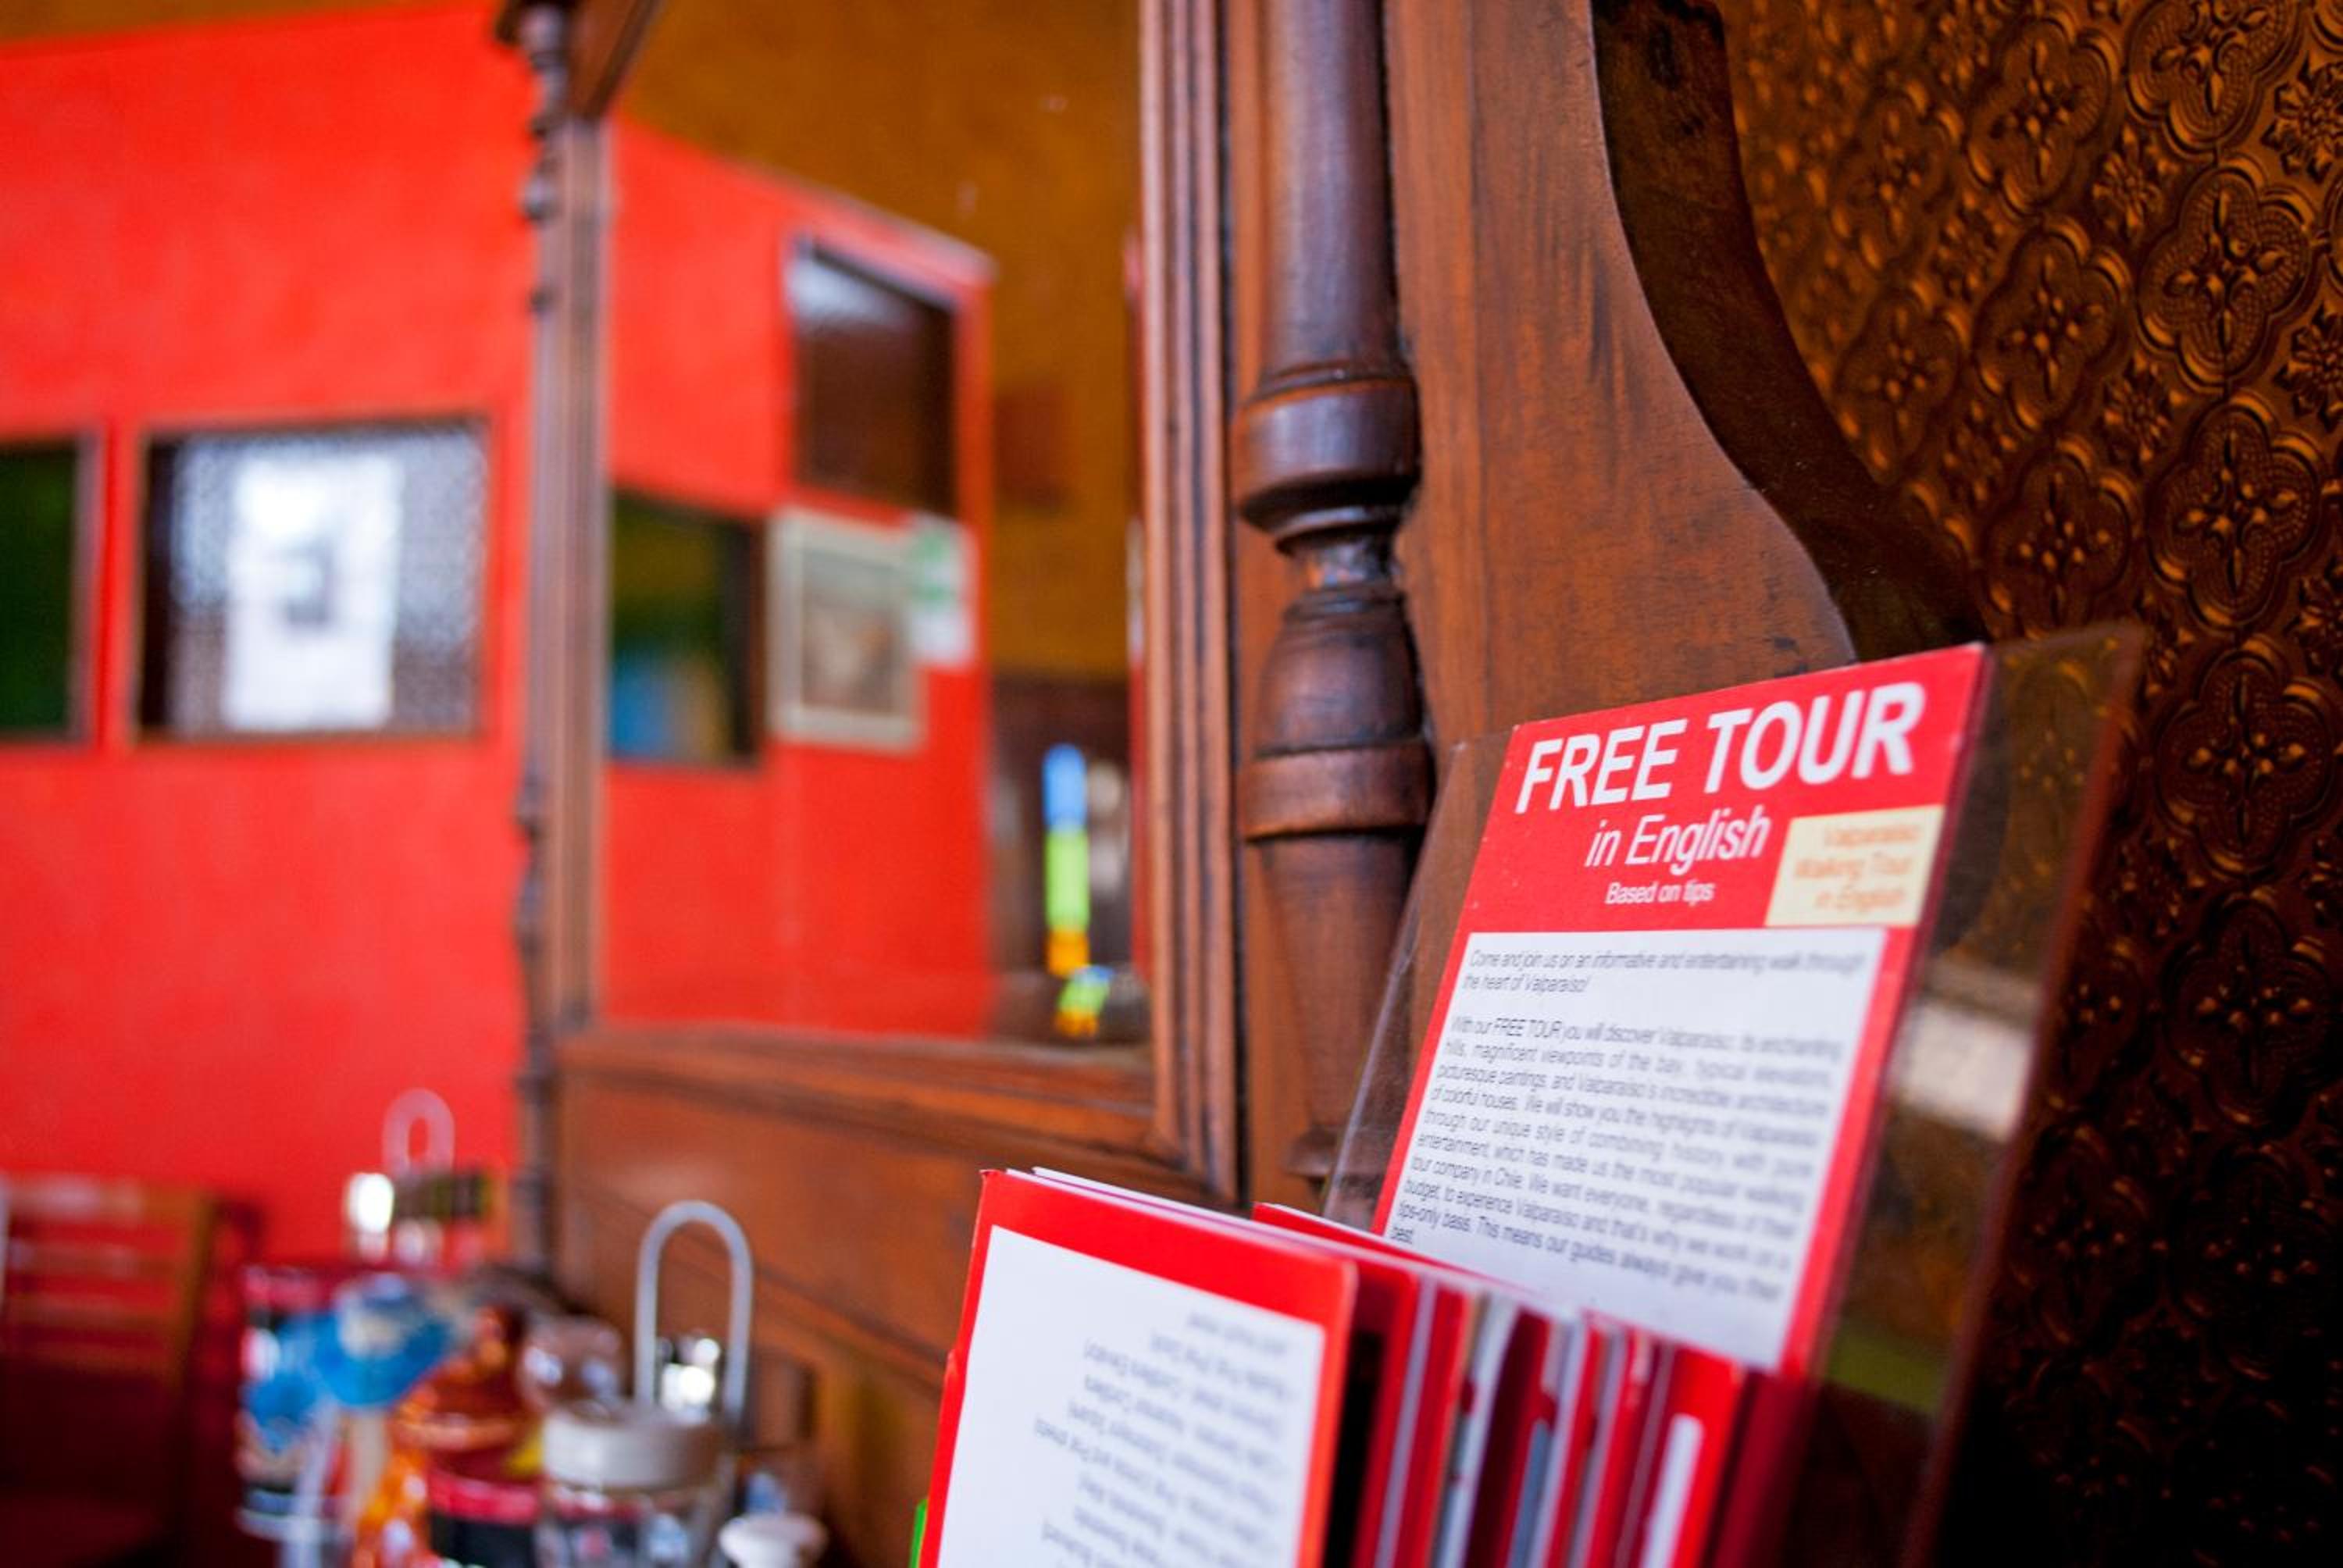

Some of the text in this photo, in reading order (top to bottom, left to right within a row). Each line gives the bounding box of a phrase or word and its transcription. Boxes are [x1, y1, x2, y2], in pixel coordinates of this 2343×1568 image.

[1515, 682, 1924, 814] FREE TOUR
[1585, 804, 1771, 875] in English
[1605, 879, 1715, 907] Based on tips
[1471, 949, 1501, 967] Come
[1500, 951, 1523, 967] and
[1517, 951, 1543, 972] join
[1542, 953, 1560, 968] us
[1558, 954, 1575, 968] on
[1574, 954, 1592, 968] an
[1464, 975, 1481, 989] the
[1482, 975, 1511, 989] heart
[1510, 973, 1525, 990] of
[1453, 1015, 1475, 1034] With
[1472, 1020, 1493, 1035] our
[1493, 1017, 1527, 1037] FREE
[1528, 1018, 1562, 1039] TOUR
[1559, 1024, 1584, 1044] you
[1584, 1021, 1605, 1042] will
[1473, 1042, 1538, 1064] magnificent
[1541, 1049, 1604, 1068] viewpoints
[1607, 1049, 1626, 1068] of
[1438, 1064, 1498, 1085] picturesque
[1551, 1074, 1576, 1092] and
[1431, 1084, 1443, 1101] of
[1443, 1087, 1480, 1106] colorful
[1524, 1094, 1544, 1114] We
[1544, 1096, 1563, 1116] will
[1563, 1101, 1596, 1120] show
[1596, 1107, 1621, 1125] you
[1425, 1110, 1467, 1133] through
[1468, 1117, 1490, 1133] our
[1492, 1120, 1532, 1140] unique
[1535, 1124, 1566, 1146] style
[1568, 1125, 1586, 1146] of
[1412, 1156, 1432, 1173] tour
[1433, 1163, 1480, 1185] company
[1481, 1169, 1493, 1184] in
[1528, 1174, 1550, 1194] We
[1551, 1182, 1583, 1199] want
[1493, 1145, 1525, 1163] which
[1528, 1149, 1550, 1167] has
[1553, 1153, 1589, 1173] made
[1590, 1163, 1607, 1176] us
[1611, 1162, 1636, 1181] the
[1443, 1186, 1456, 1203] to
[1456, 1191, 1514, 1218] experience
[1581, 1215, 1609, 1235] and
[1399, 1203, 1441, 1229] tips-only
[1477, 1218, 1500, 1239] This
[1503, 1228, 1543, 1249] means
[1546, 1238, 1569, 1255] our
[1569, 1242, 1617, 1266] guides
